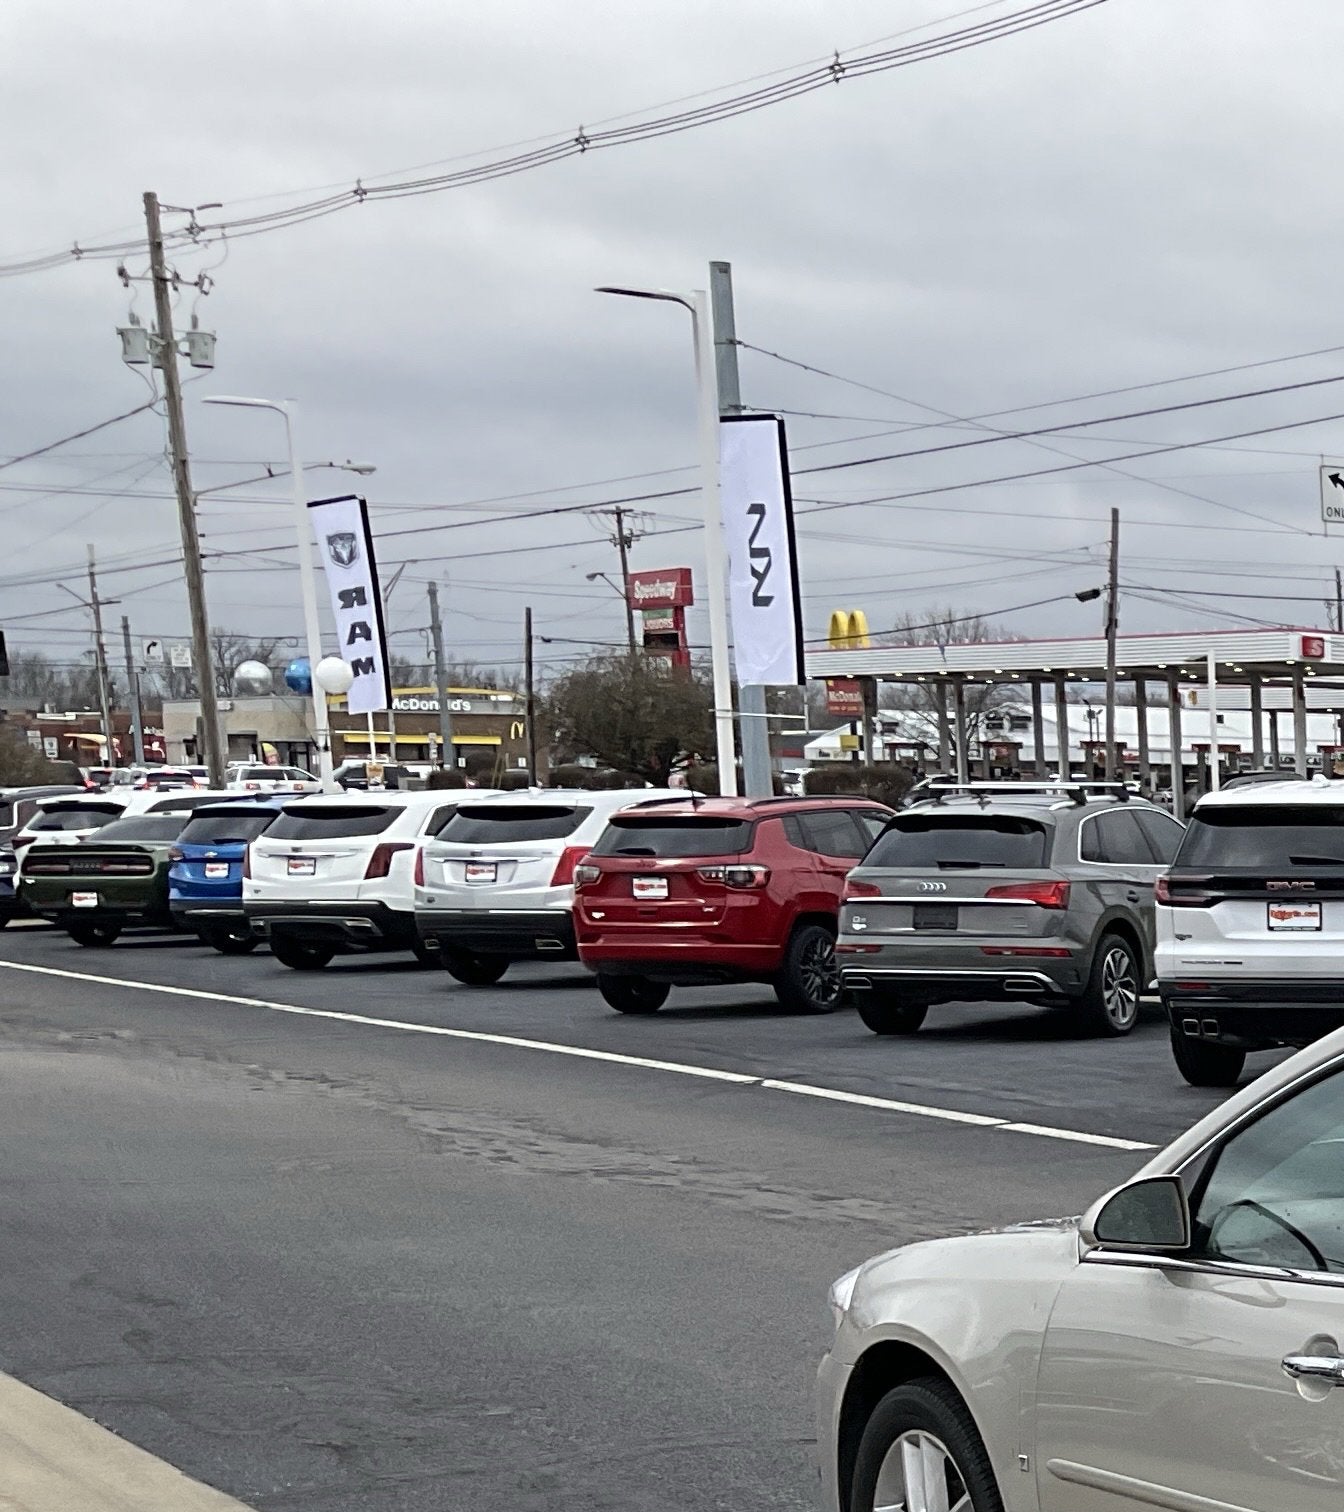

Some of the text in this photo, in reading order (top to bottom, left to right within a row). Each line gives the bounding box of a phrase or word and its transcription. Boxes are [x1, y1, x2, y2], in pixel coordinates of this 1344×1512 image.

[634, 579, 677, 604] Speedway
[391, 699, 472, 711] McDonld's
[1266, 881, 1316, 891] GMC
